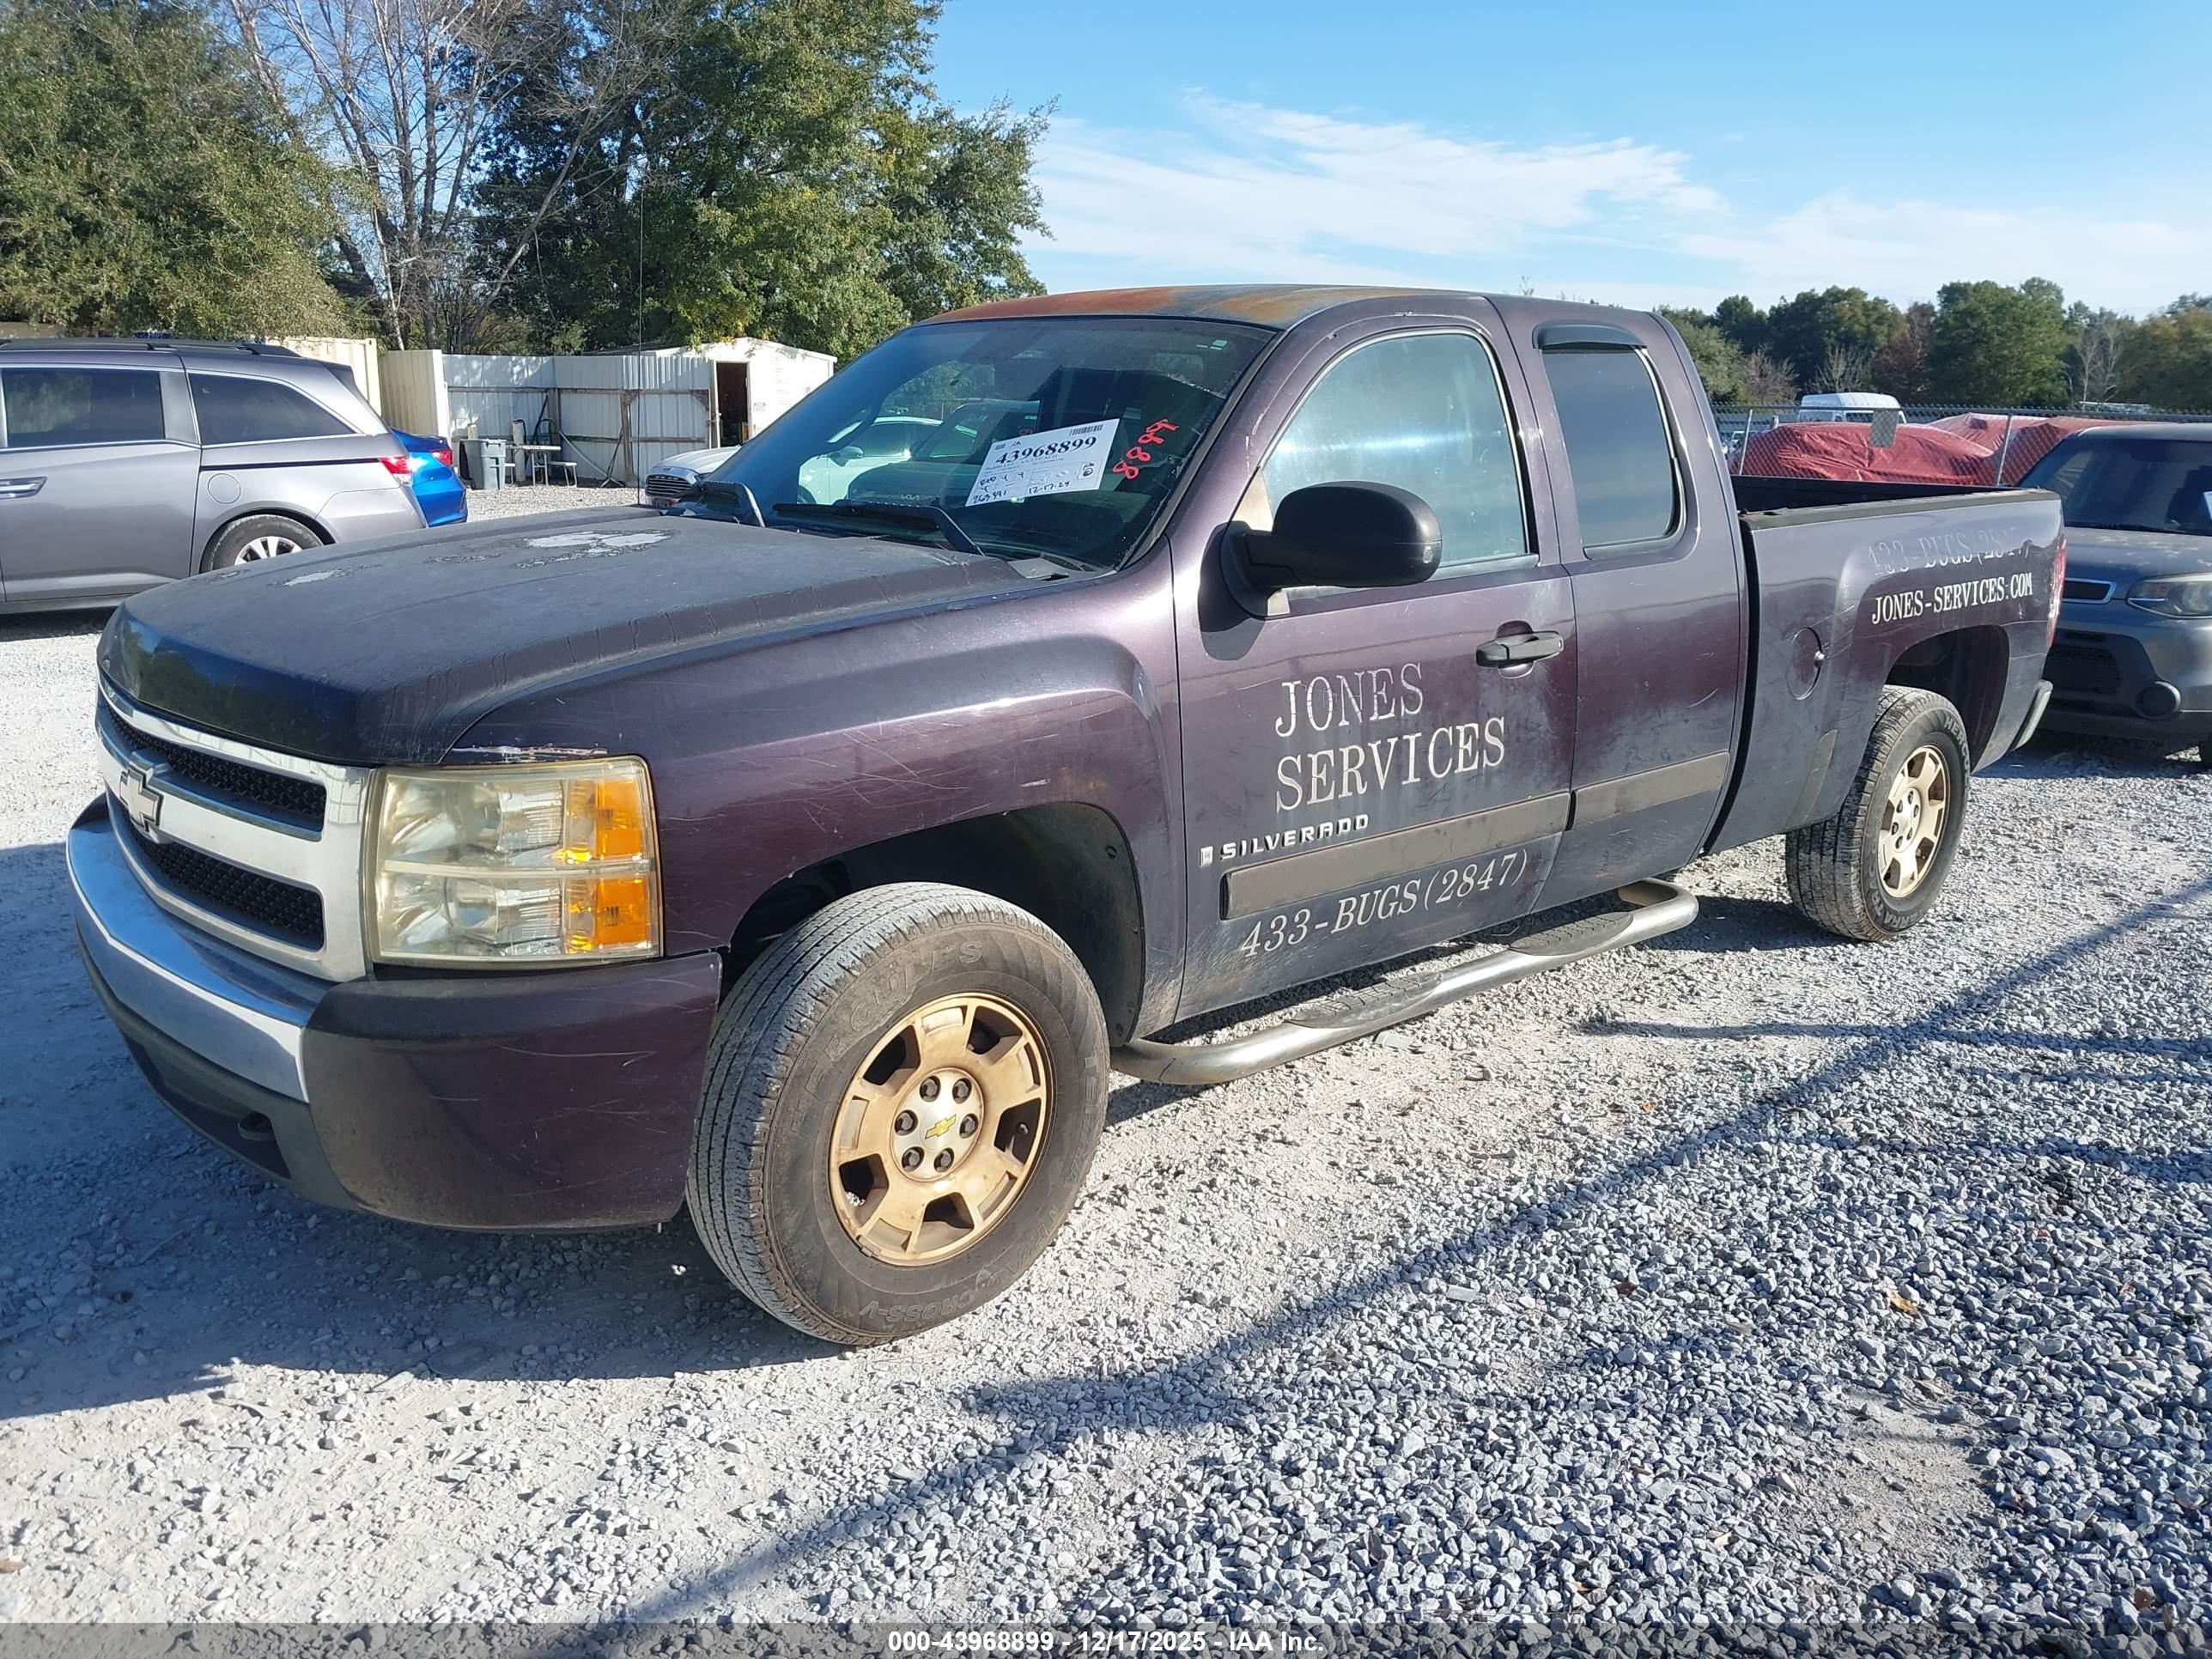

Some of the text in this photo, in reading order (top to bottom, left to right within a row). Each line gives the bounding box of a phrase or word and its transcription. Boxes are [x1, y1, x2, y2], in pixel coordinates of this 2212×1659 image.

[995, 436, 1097, 465] 43968899
[1872, 573, 2033, 624] JONES-SERVICES.COM
[1275, 662, 1424, 737] JONES
[1276, 716, 1505, 812] SERVICES
[1221, 814, 1369, 860] SILVERADO
[1240, 849, 1528, 957] 433-BUGS(2847)
